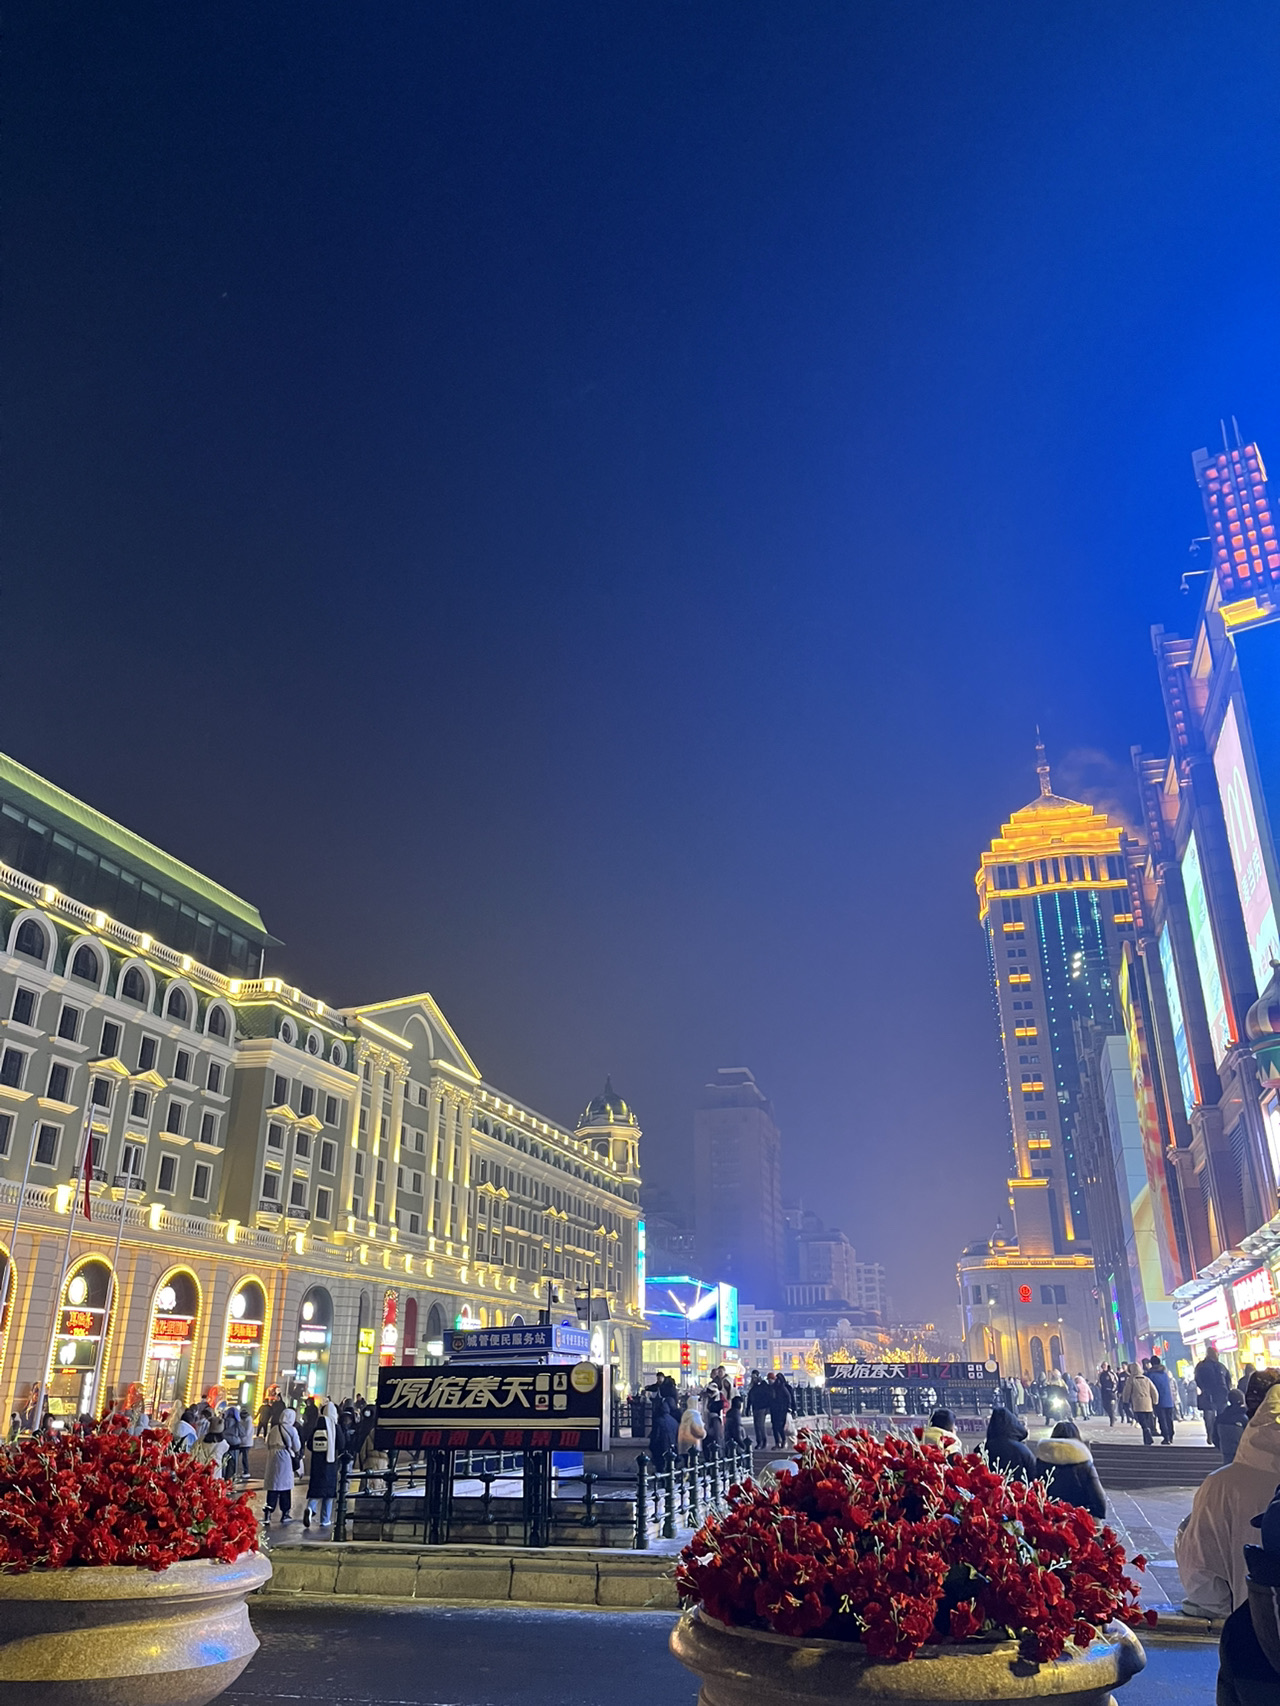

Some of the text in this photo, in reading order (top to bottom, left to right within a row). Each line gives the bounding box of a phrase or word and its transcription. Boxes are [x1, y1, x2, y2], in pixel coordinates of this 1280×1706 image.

[1241, 847, 1262, 908] 麦当劳
[466, 1332, 546, 1348] 城管便民服务站
[829, 1363, 906, 1379] 原宿春天
[380, 1375, 534, 1409] 原宿春天
